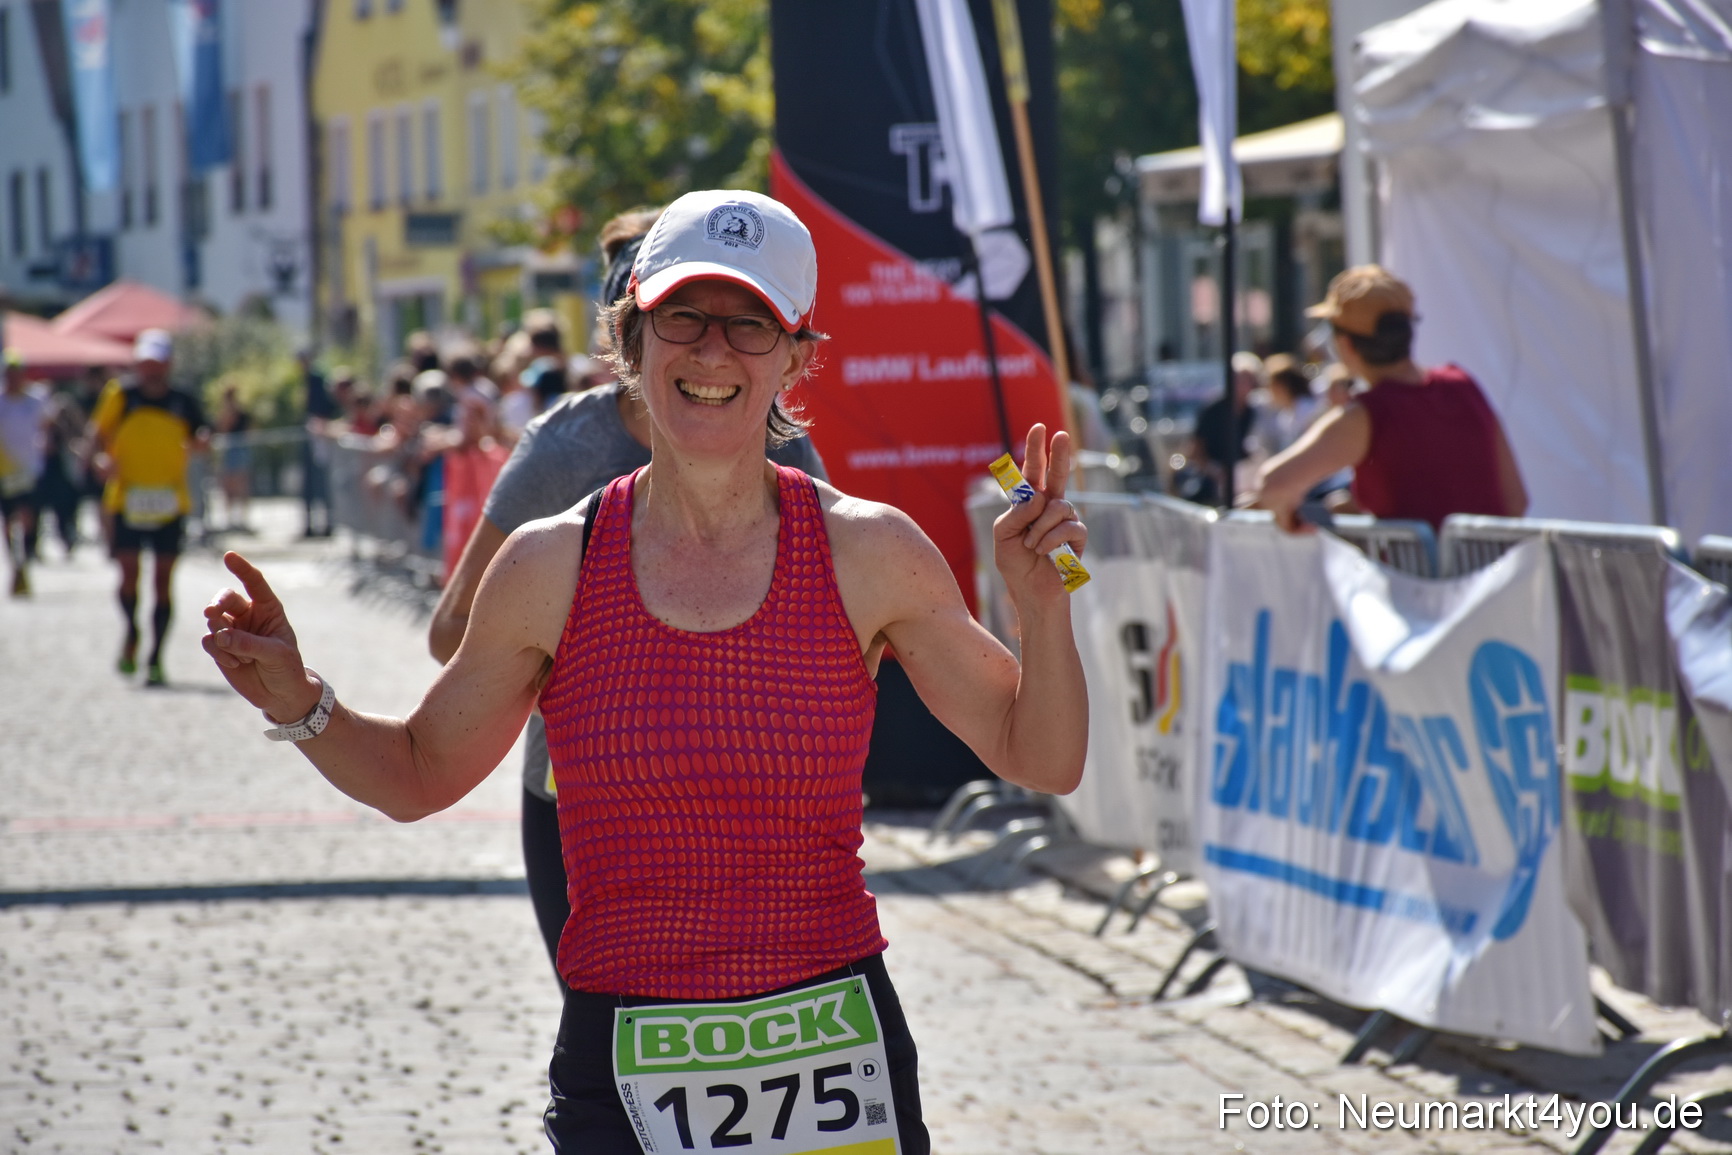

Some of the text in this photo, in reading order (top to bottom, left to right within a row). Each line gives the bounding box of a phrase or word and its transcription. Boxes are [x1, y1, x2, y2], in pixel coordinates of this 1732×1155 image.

[719, 206, 748, 215] ATHLETIC
[843, 355, 914, 384] BMW
[634, 991, 861, 1066] BOCK
[863, 1063, 875, 1077] D
[653, 1062, 860, 1150] 1275
